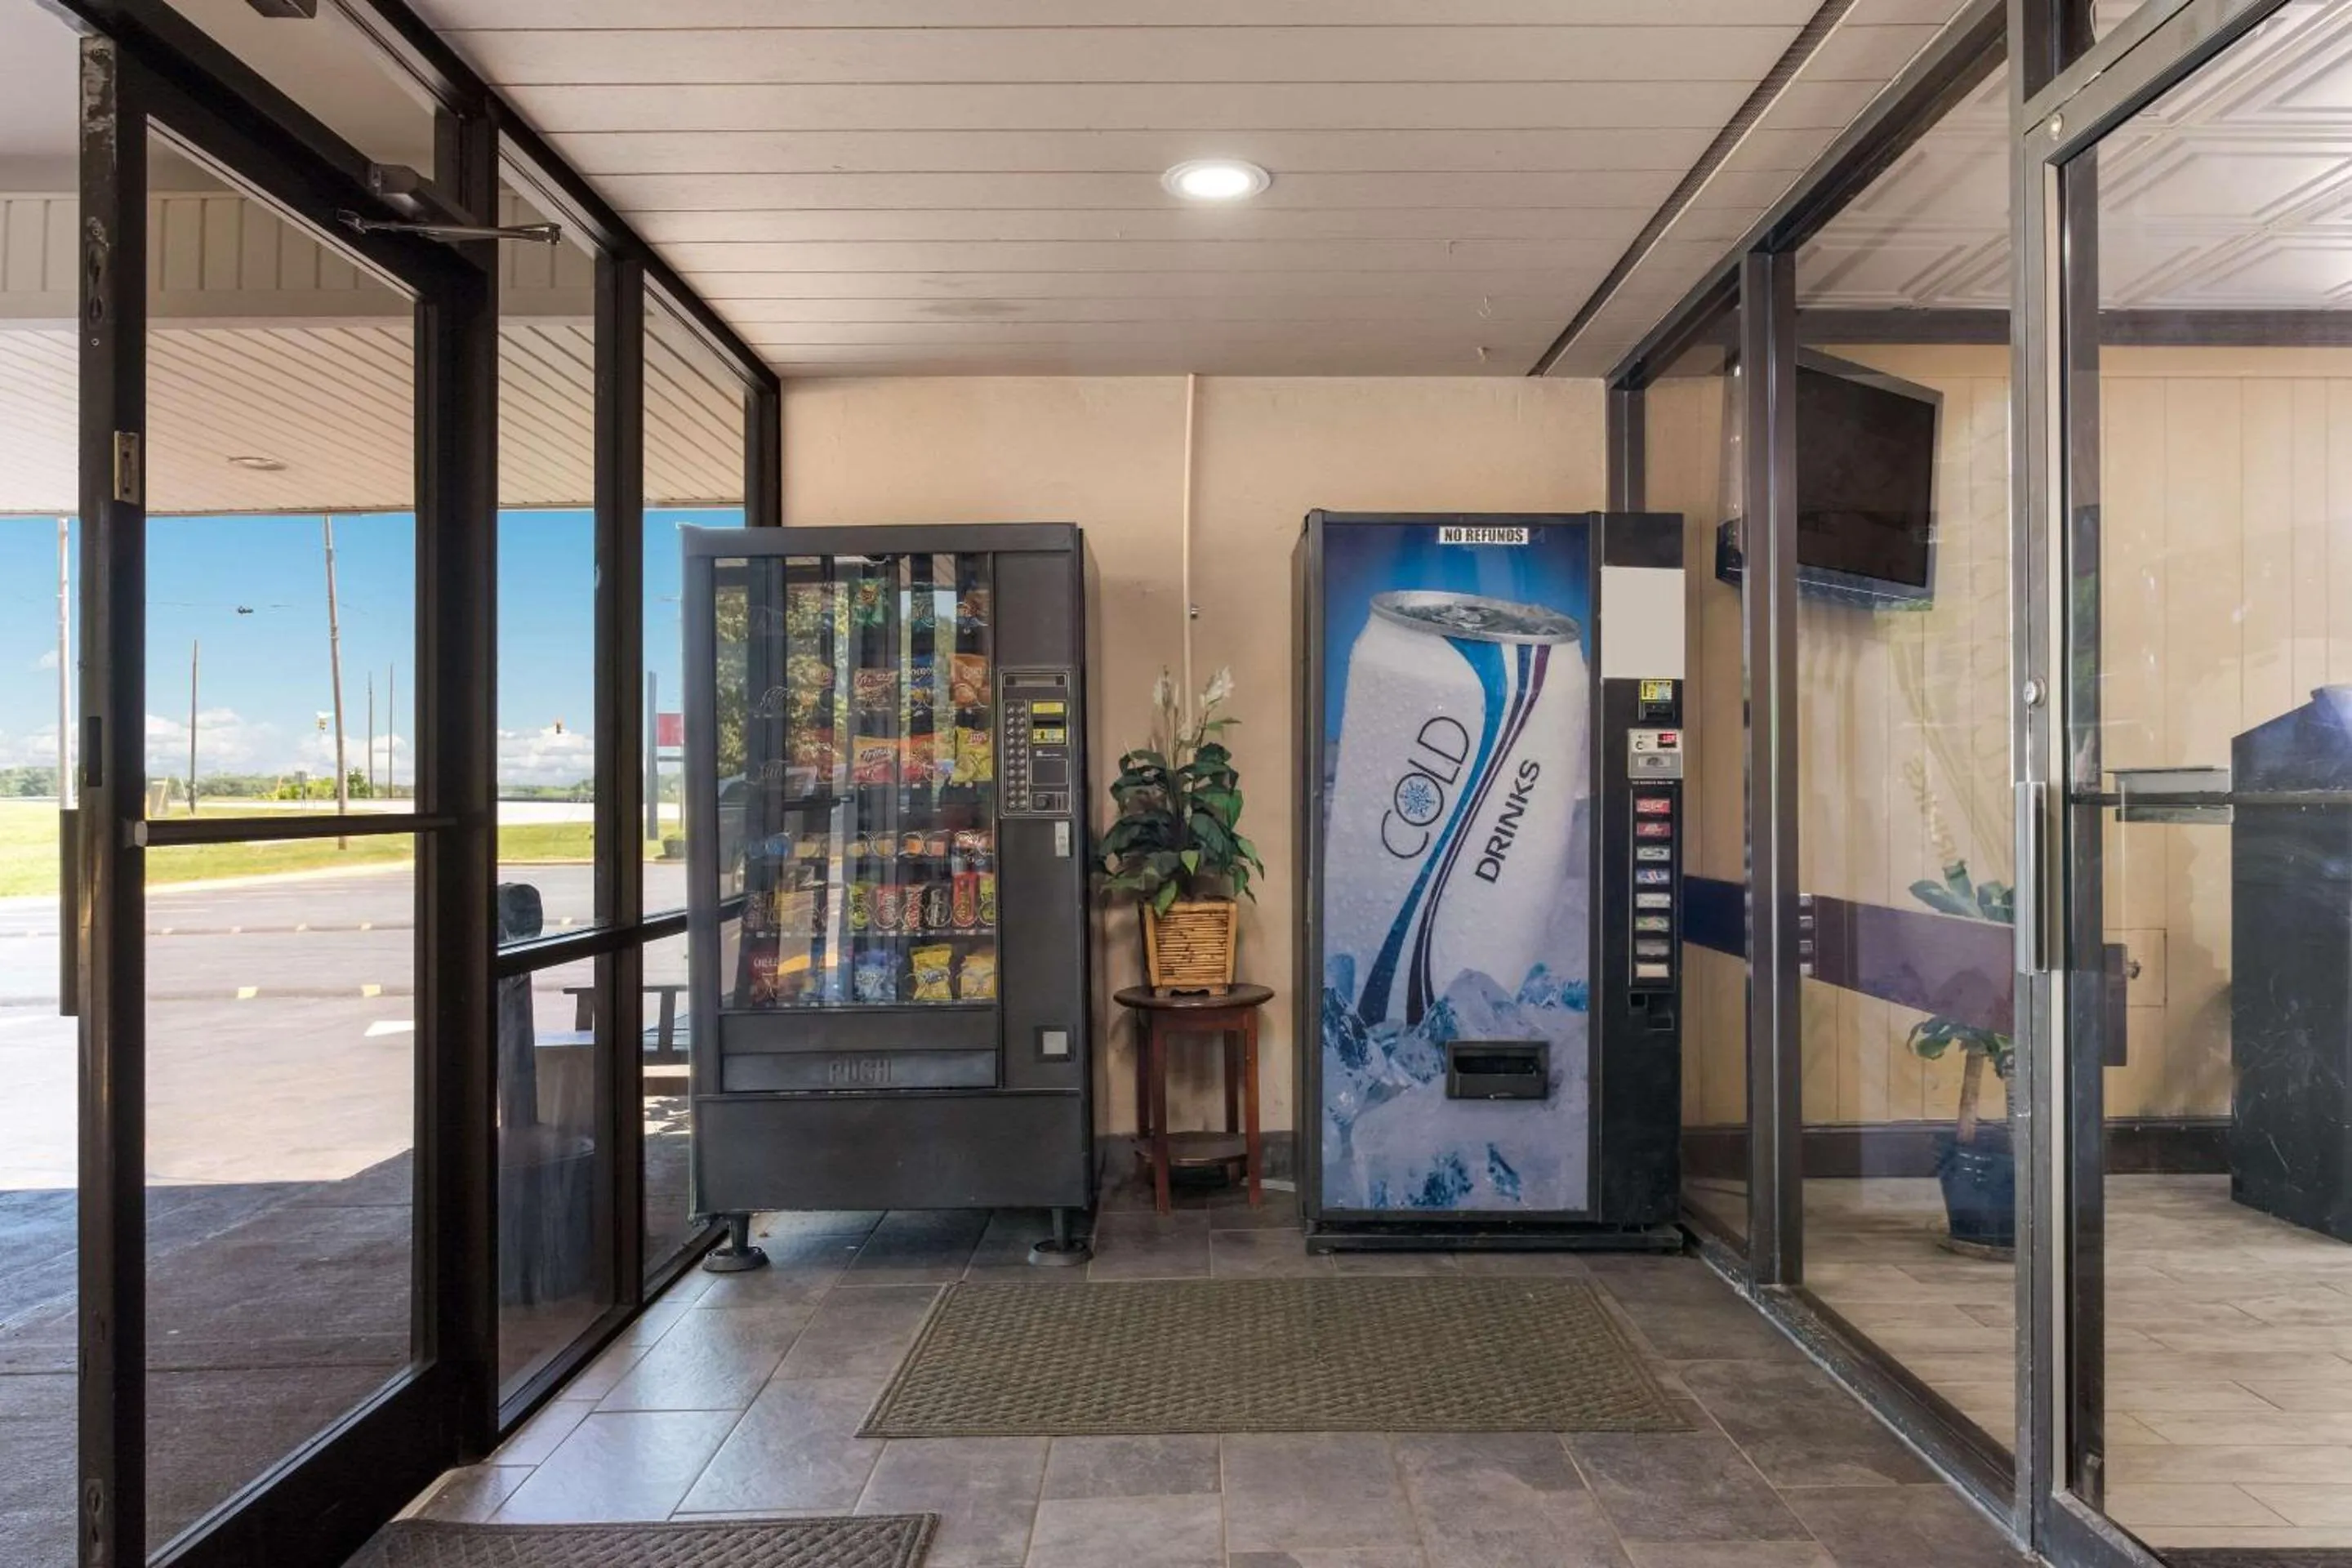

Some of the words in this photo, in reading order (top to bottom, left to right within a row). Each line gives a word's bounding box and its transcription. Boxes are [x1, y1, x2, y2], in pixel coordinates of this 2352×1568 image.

[1444, 528, 1462, 541] NO
[1465, 528, 1524, 543] REFUNDS
[1381, 716, 1469, 859] COLD
[1475, 760, 1540, 884] DRINKS
